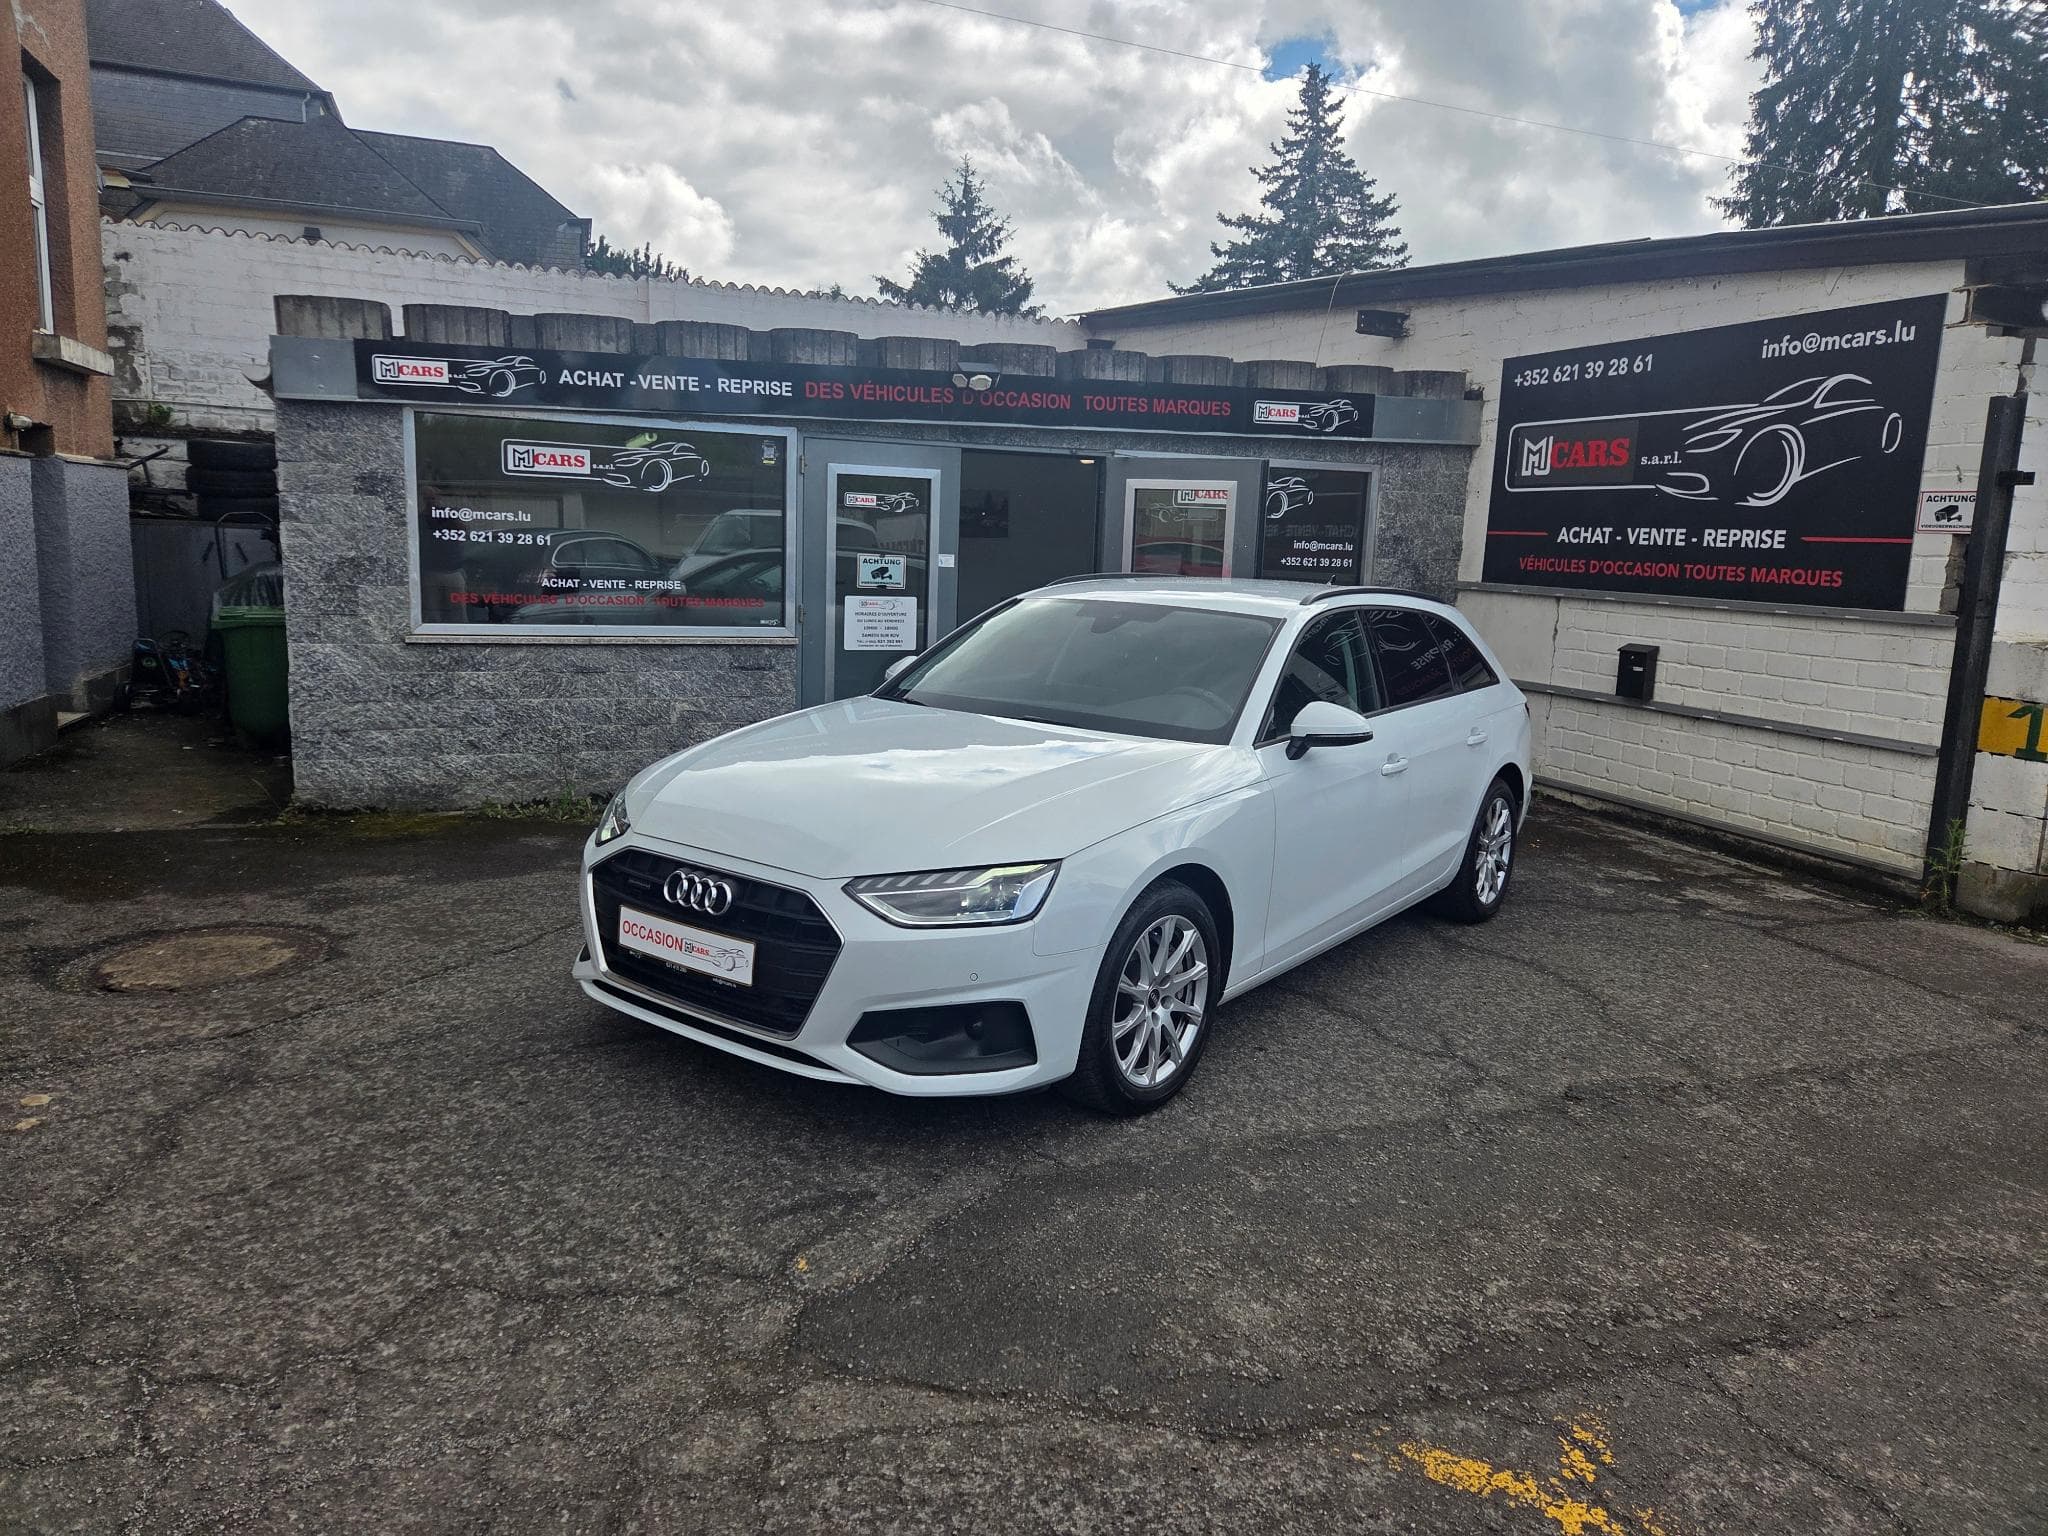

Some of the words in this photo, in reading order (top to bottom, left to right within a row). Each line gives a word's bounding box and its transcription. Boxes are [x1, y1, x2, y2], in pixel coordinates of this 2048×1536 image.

[1761, 319, 1916, 359] info@mcars.lu
[1514, 367, 1549, 387] +352
[1552, 363, 1579, 383] 621
[1584, 360, 1604, 379] 39
[1607, 357, 1629, 376] 28
[1633, 353, 1653, 373] 61
[559, 369, 625, 388] ACHAT
[717, 377, 793, 397] REPRISE
[805, 381, 844, 399] DES
[849, 379, 954, 404] VÉHICULES
[1083, 395, 1148, 413] TOUTES
[1152, 398, 1231, 417] MARQUES
[1640, 451, 1682, 465] s.a.r.l.
[1926, 495, 1976, 503] ACHTUNG
[431, 506, 531, 522] info@mcars.lu
[433, 529, 466, 542] +352
[469, 530, 493, 543] 621
[497, 532, 514, 544] 39
[517, 533, 533, 545] 28
[536, 534, 551, 546] 61
[1556, 526, 1613, 544] ACHAT
[1627, 527, 1687, 547] VENTE
[1702, 528, 1787, 549] REPRISE
[1293, 540, 1353, 552] info@mcars.lu
[862, 558, 901, 566] ACHTUNG
[1280, 557, 1301, 566] +352
[1302, 557, 1317, 567] 621
[1319, 558, 1329, 567] 39
[1331, 558, 1341, 567] 28
[1343, 558, 1353, 568] 61
[1519, 554, 1586, 573] VÉHICULES
[1684, 564, 1745, 582] TOUTES
[1750, 567, 1843, 588] MARQUES
[541, 578, 580, 588] ACHAT
[588, 579, 626, 589] VENTE
[635, 580, 681, 590] REPRISE
[450, 592, 478, 605] DES
[2006, 703, 2048, 762] 1
[622, 920, 683, 953] OCCASION
